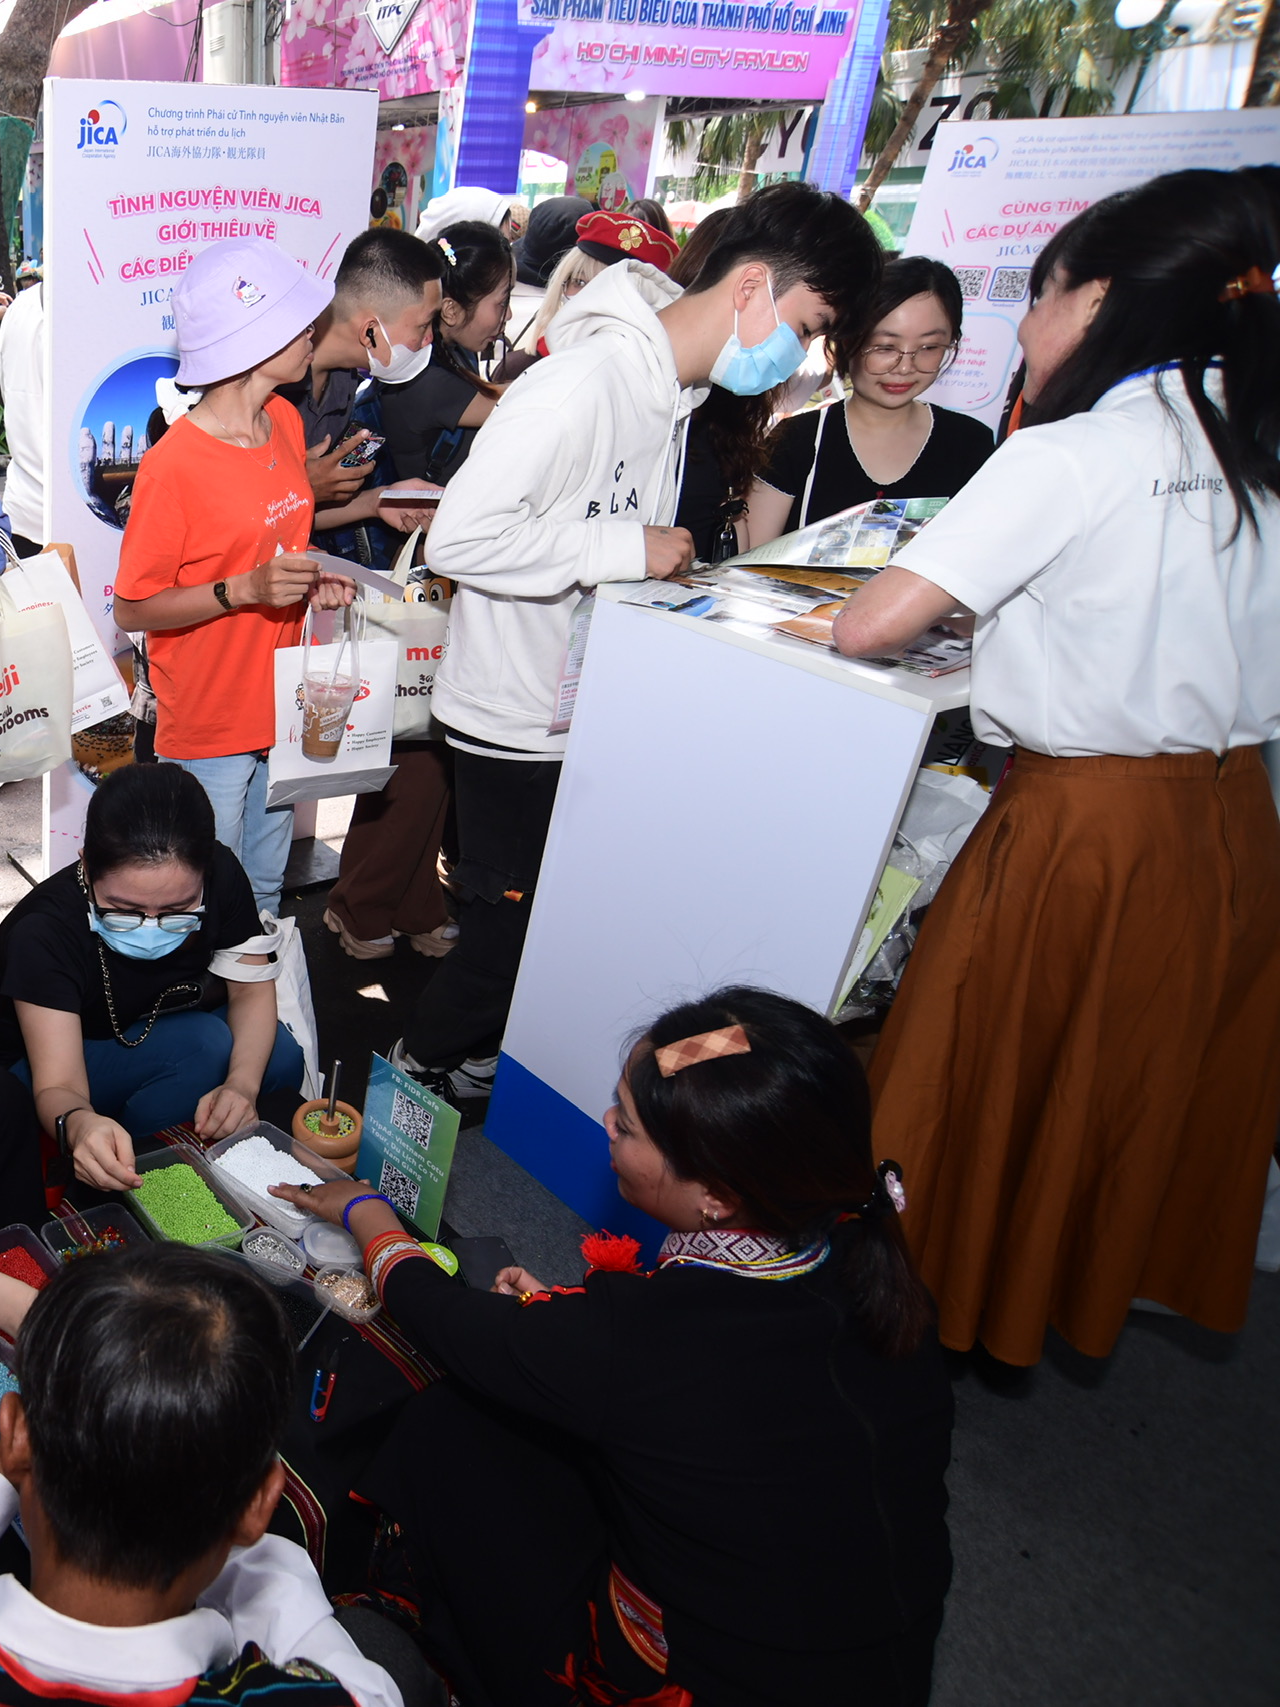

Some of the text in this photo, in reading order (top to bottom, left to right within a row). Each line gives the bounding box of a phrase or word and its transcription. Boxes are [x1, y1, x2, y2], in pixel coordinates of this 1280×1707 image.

[609, 44, 640, 63] CHI
[644, 46, 687, 66] MINH
[691, 47, 731, 68] CITY
[733, 50, 810, 71] PAVILION
[148, 107, 183, 121] Chương
[207, 109, 225, 120] Phái
[259, 112, 289, 124] nguyện
[291, 112, 308, 122] viên
[309, 112, 328, 124] Nhật
[330, 113, 345, 124] Bản
[161, 127, 173, 138] trợ
[176, 126, 195, 138] phát
[197, 126, 216, 137] triển
[218, 127, 229, 137] du
[231, 128, 246, 139] lịch
[109, 186, 321, 216] TÌNH NGUYỆN VIÊN JICA
[1001, 198, 1089, 216] CÙNG TÌM
[158, 219, 197, 241] GIỚI
[255, 218, 277, 240] VỀ
[966, 221, 1057, 240] CÁC DỰ ÁN
[996, 243, 1045, 258] JICAの
[120, 258, 155, 279] CÁC
[140, 287, 173, 306] JICA
[1150, 473, 1224, 497] Leading
[406, 645, 443, 661] me
[418, 674, 435, 685] きの
[395, 684, 433, 697] hoco
[391, 1073, 441, 1112] FB: FIDR Cafe
[369, 1115, 445, 1177] TripAd: Vietnam Cotu
[383, 1147, 423, 1182] Nam Giang
[391, 1142, 401, 1153] Du
[402, 1150, 417, 1167] Lịch
[418, 1163, 428, 1175] Co
[428, 1171, 439, 1183] Tu
